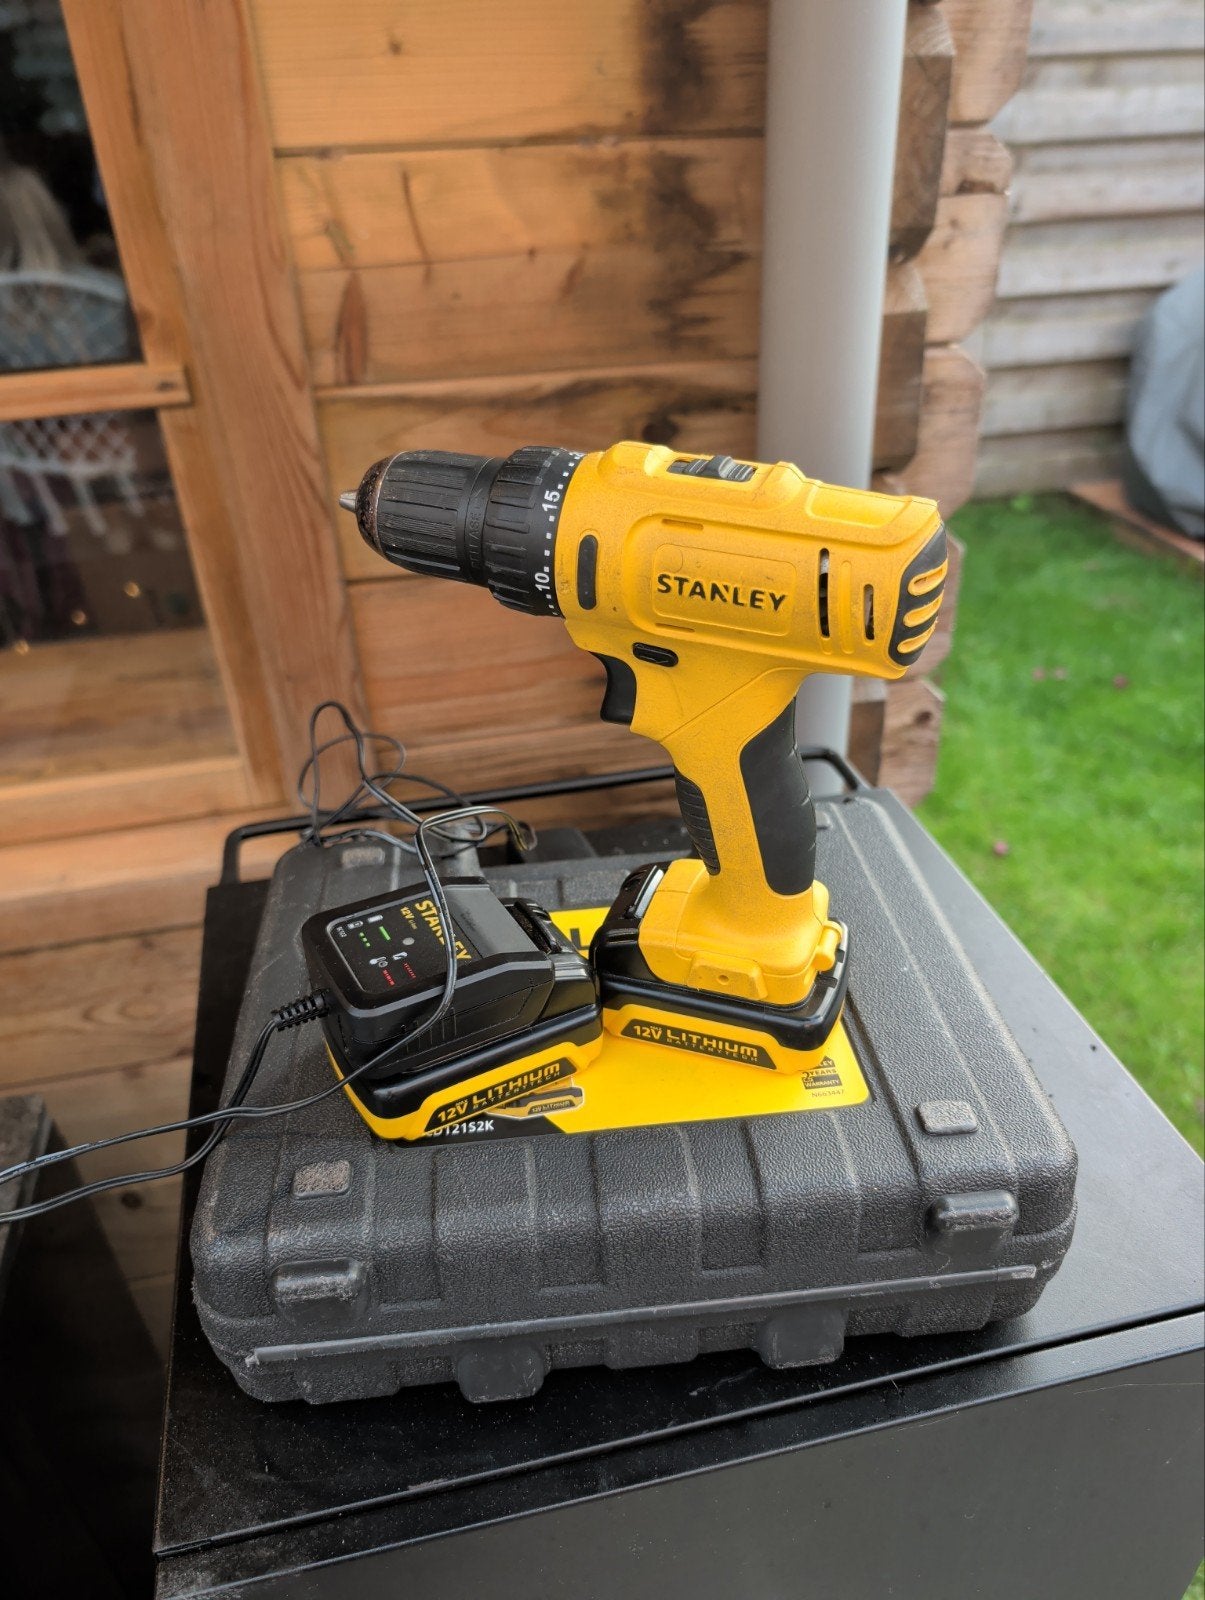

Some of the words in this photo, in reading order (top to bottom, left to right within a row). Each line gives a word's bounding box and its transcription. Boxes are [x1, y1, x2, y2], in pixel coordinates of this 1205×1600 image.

[542, 490, 560, 512] 15
[534, 572, 550, 591] 10
[657, 573, 786, 612] STANLEY
[415, 900, 472, 959] STANEY
[634, 1026, 662, 1040] 12V
[667, 1029, 758, 1057] LITHIUM
[438, 1102, 468, 1122] 12V
[472, 1063, 560, 1105] LITHIUM
[427, 1120, 495, 1137] 121S2K
